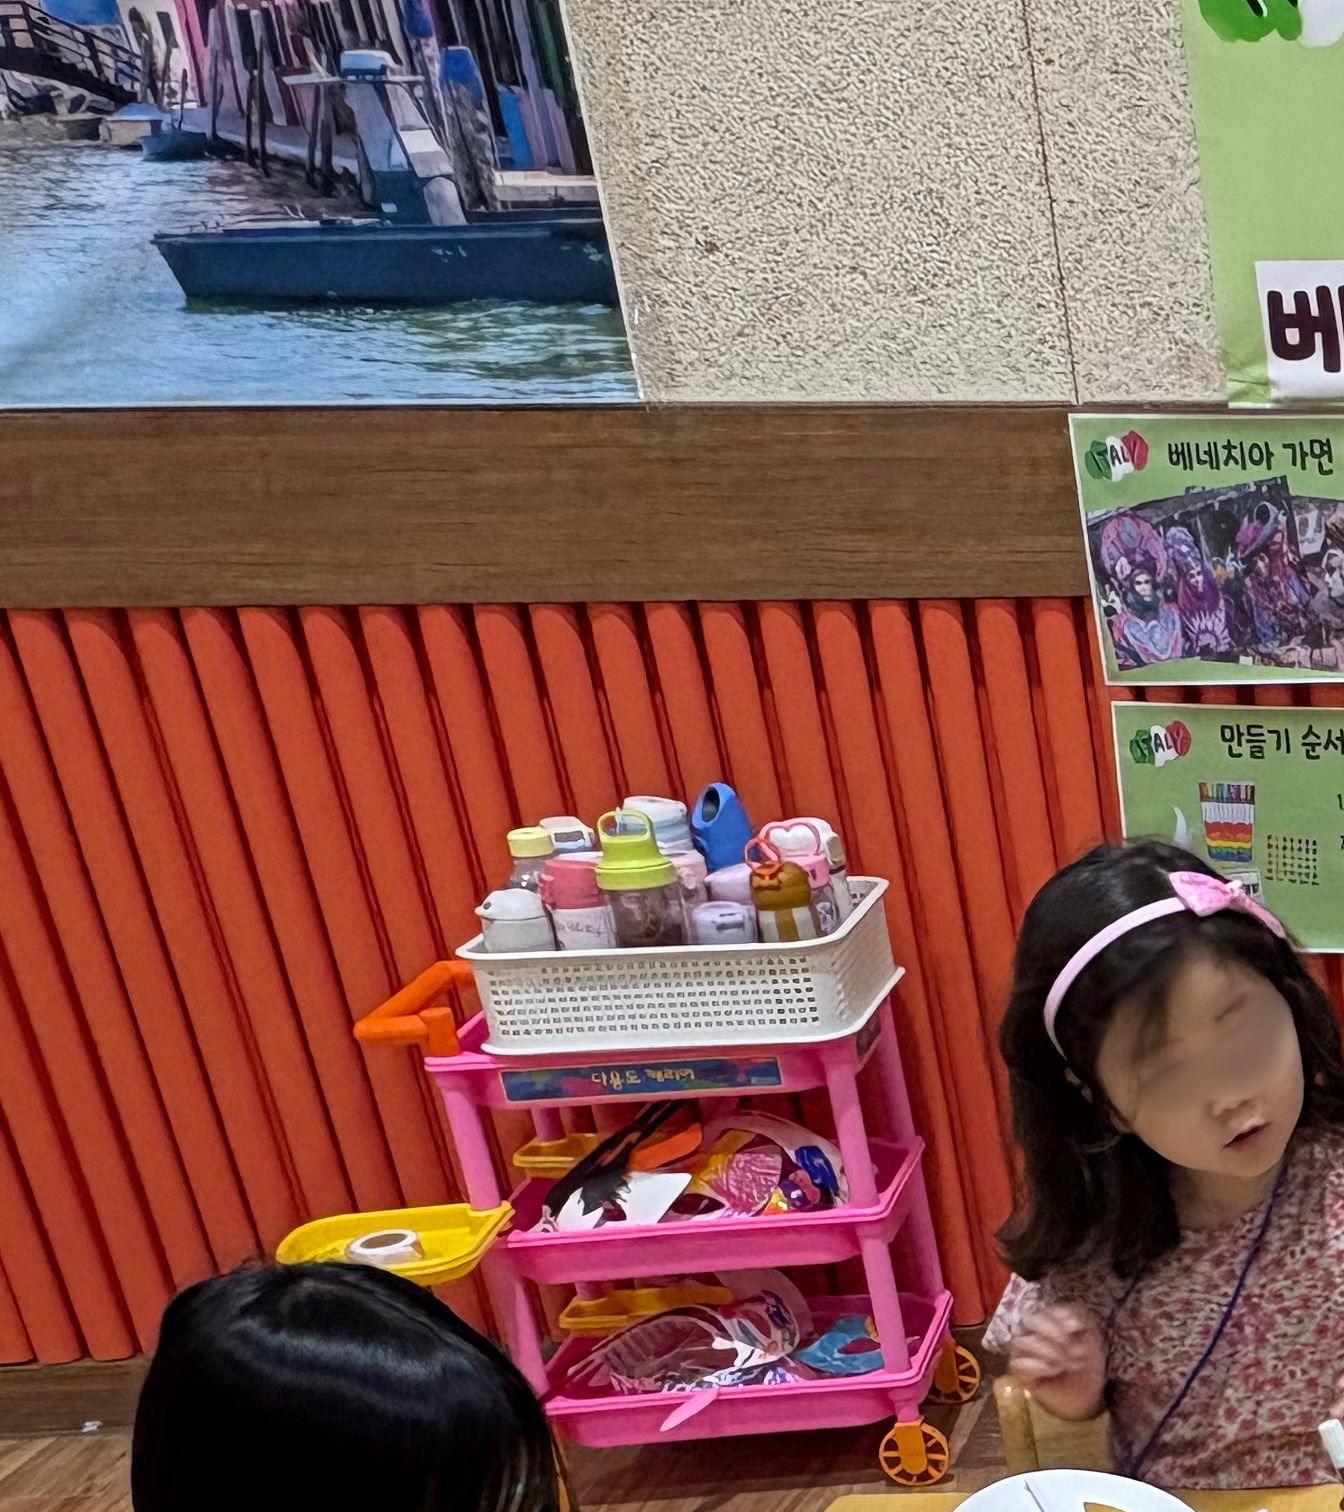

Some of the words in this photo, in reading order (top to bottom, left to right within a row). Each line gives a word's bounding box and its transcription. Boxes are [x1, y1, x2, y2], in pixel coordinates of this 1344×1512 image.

[1167, 438, 1275, 471] 베네치아
[1282, 441, 1335, 476] 가면
[1219, 723, 1291, 761] 만들기
